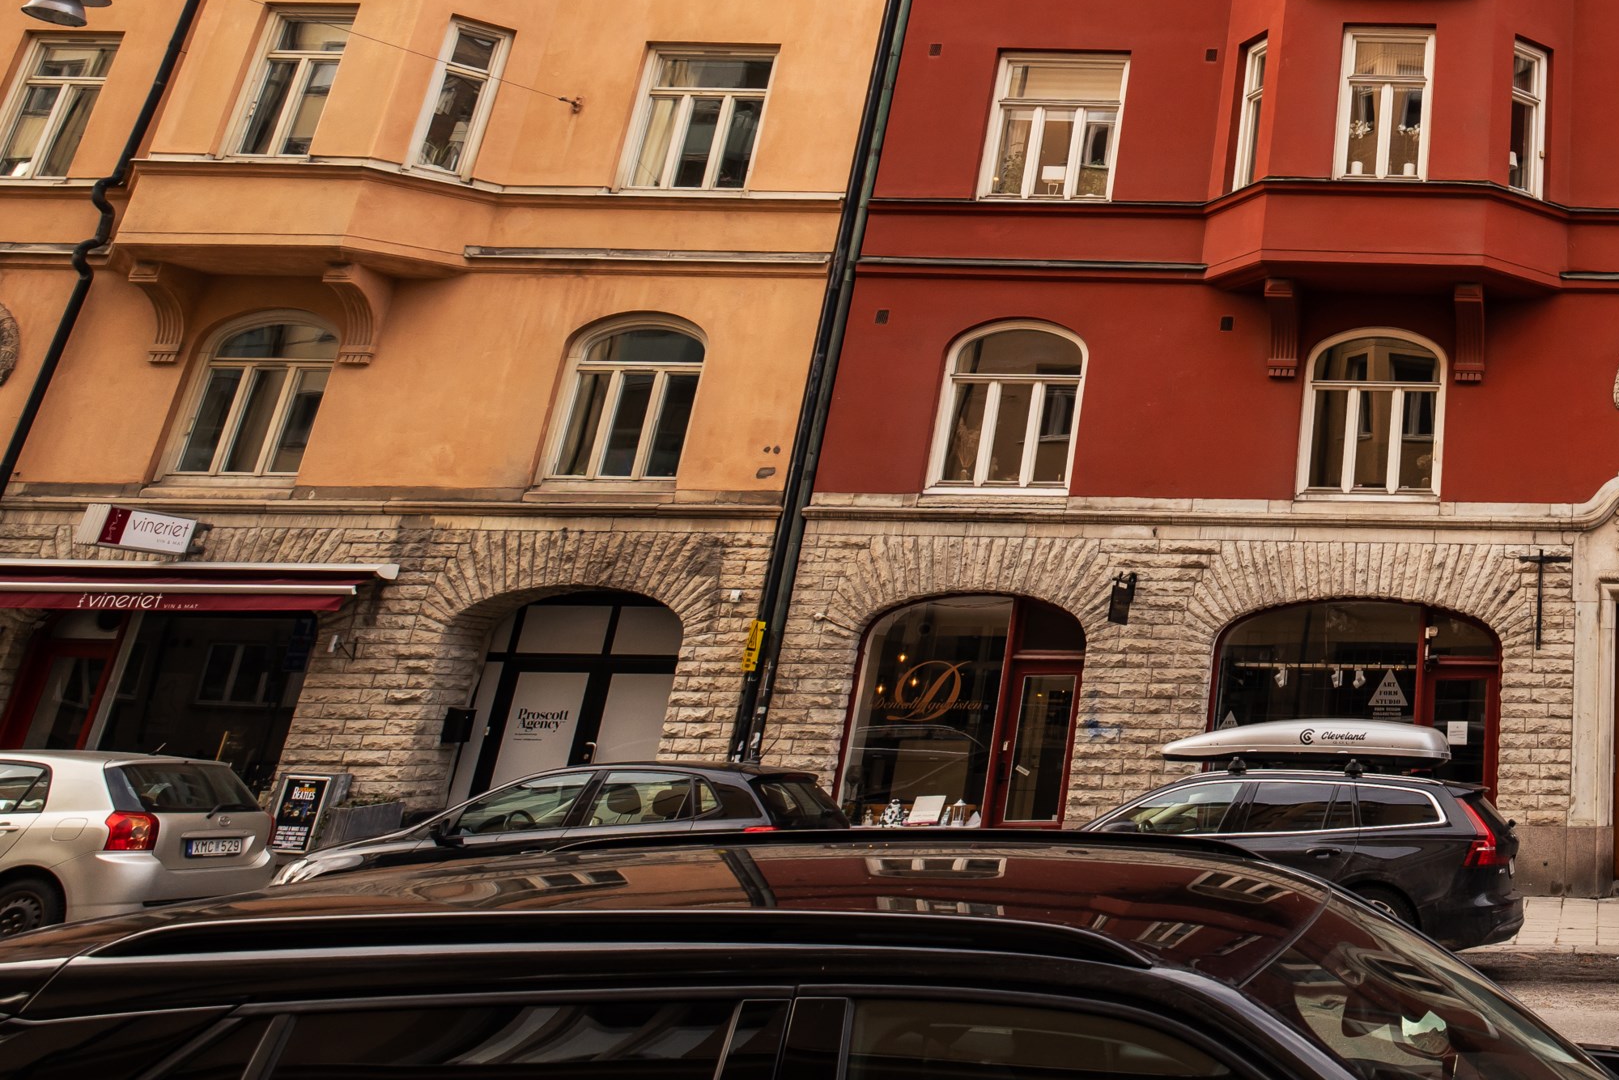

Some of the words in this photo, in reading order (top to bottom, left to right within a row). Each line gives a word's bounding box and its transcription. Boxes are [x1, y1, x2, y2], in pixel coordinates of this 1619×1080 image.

[133, 517, 189, 538] vineriet
[88, 592, 163, 609] vineriet
[518, 708, 569, 720] Proscott
[517, 718, 561, 733] Agency
[1321, 731, 1367, 740] Cleveland
[194, 840, 214, 853] XMC
[220, 840, 240, 852] 529
